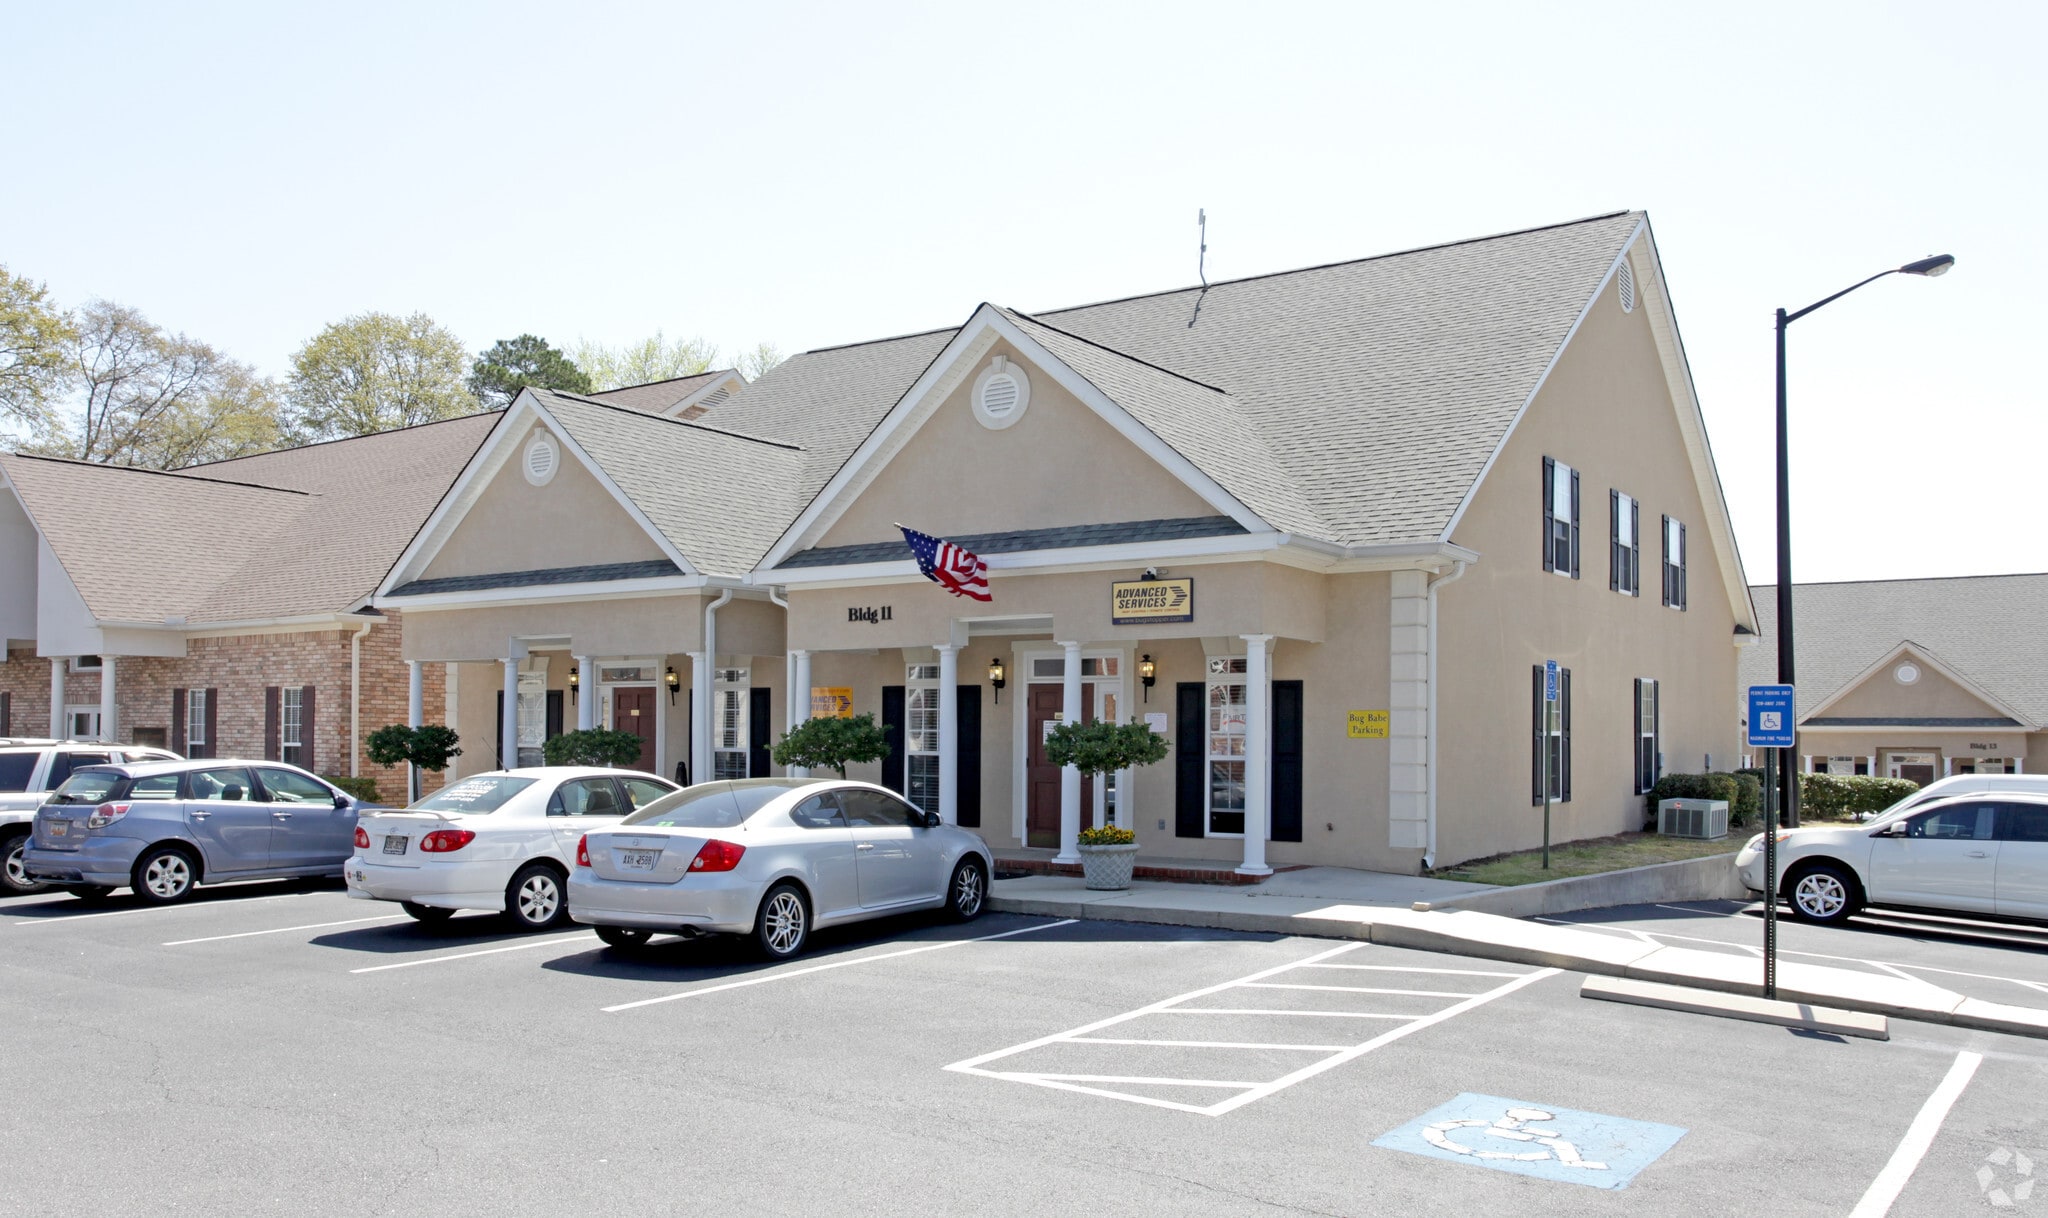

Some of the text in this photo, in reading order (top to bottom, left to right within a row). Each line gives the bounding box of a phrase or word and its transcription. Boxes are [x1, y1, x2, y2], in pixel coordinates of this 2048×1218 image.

[1115, 586, 1168, 599] ADVANCED
[1118, 597, 1167, 609] SERVICES
[848, 605, 893, 624] Bldg 11
[1223, 713, 1247, 721] FAIRT
[1349, 713, 1387, 725] Bug Babe
[1352, 725, 1384, 737] Parking
